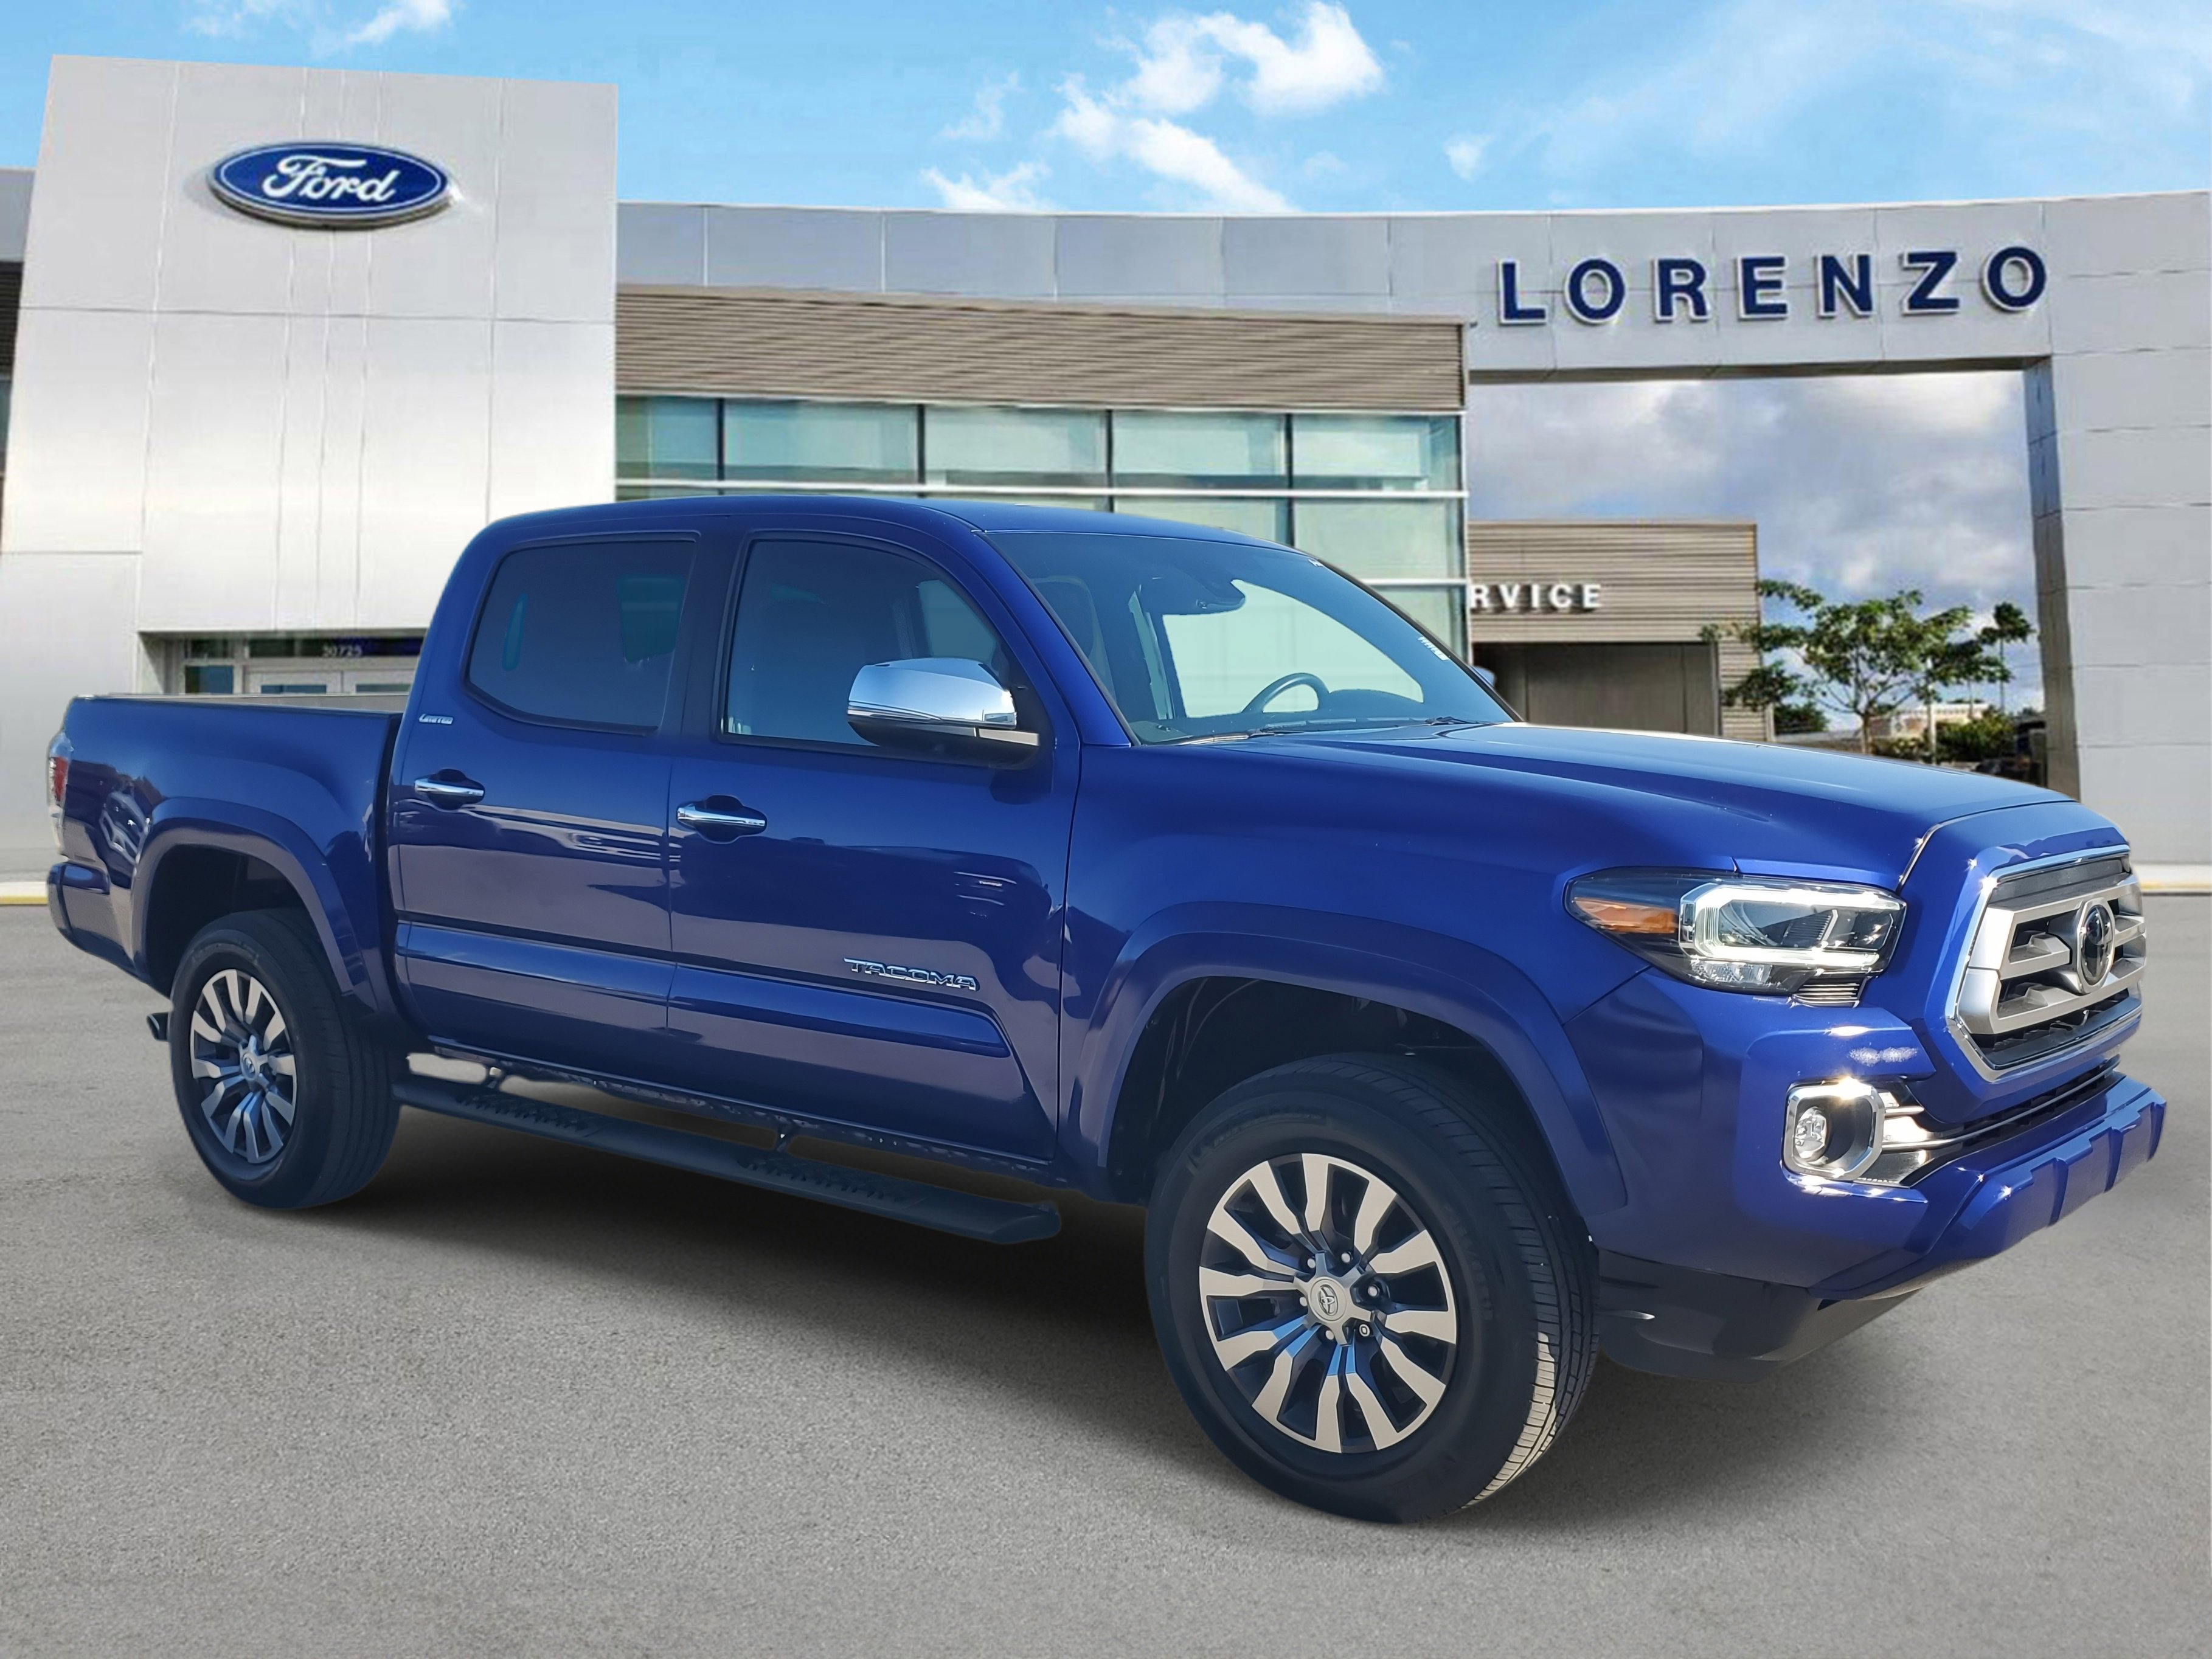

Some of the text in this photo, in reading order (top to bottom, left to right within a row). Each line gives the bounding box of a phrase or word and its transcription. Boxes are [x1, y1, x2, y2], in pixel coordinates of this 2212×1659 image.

[262, 154, 401, 202] Ford
[1498, 246, 2048, 324] LORENZO
[844, 958, 977, 991] TACOMA
